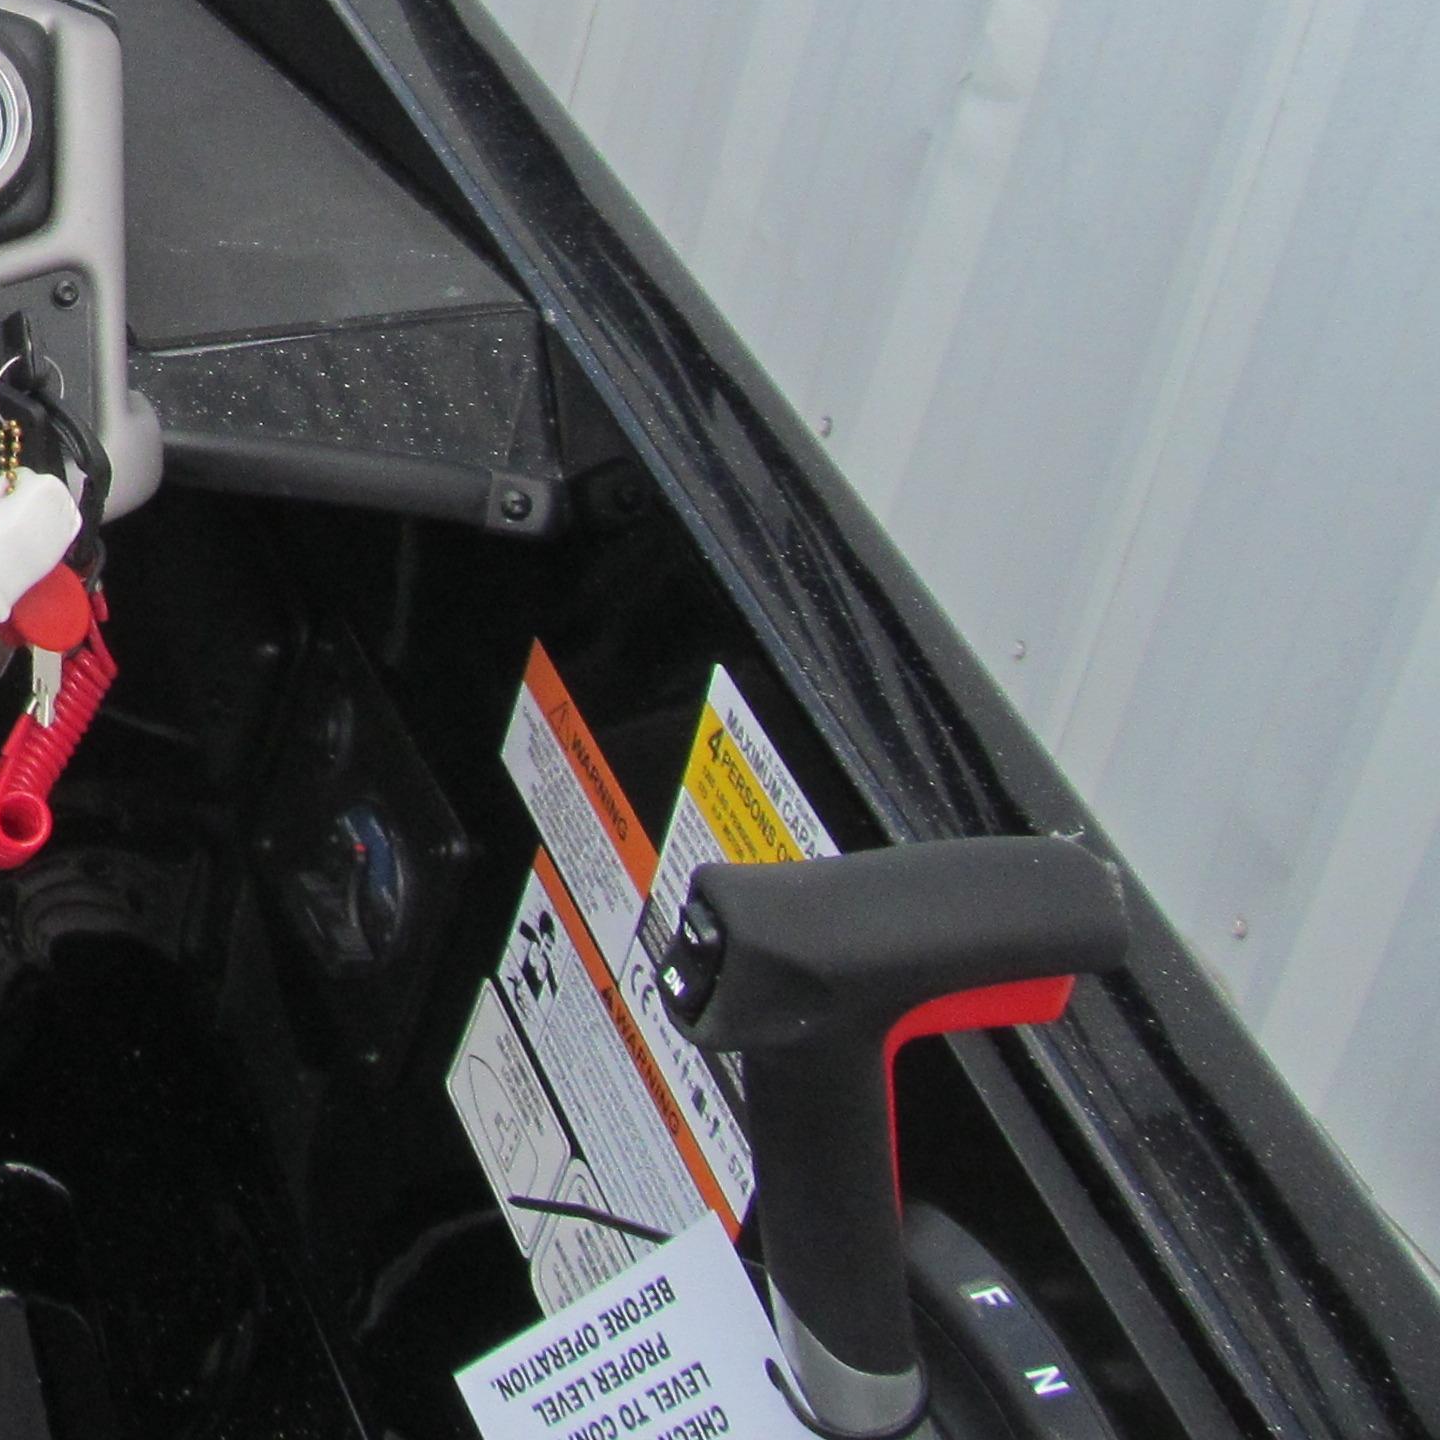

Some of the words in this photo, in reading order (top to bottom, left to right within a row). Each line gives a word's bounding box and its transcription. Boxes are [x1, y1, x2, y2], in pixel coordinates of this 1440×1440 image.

[572, 731, 628, 841] WARNING
[707, 728, 724, 762] 4
[721, 751, 776, 847] PERSONS
[726, 708, 784, 806] MAXIMUM
[783, 802, 825, 859] CAPA
[663, 966, 685, 996] DN
[615, 1013, 679, 1137] WARNING
[598, 1274, 676, 1341] BEFORE
[970, 1286, 1011, 1305] F
[490, 1322, 600, 1402] OPERATION.
[591, 1331, 672, 1395] PROPER
[644, 1361, 712, 1414] LEVEL
[1024, 1365, 1071, 1395] N
[531, 1377, 596, 1427] LEVEL
[618, 1398, 652, 1432] TO
